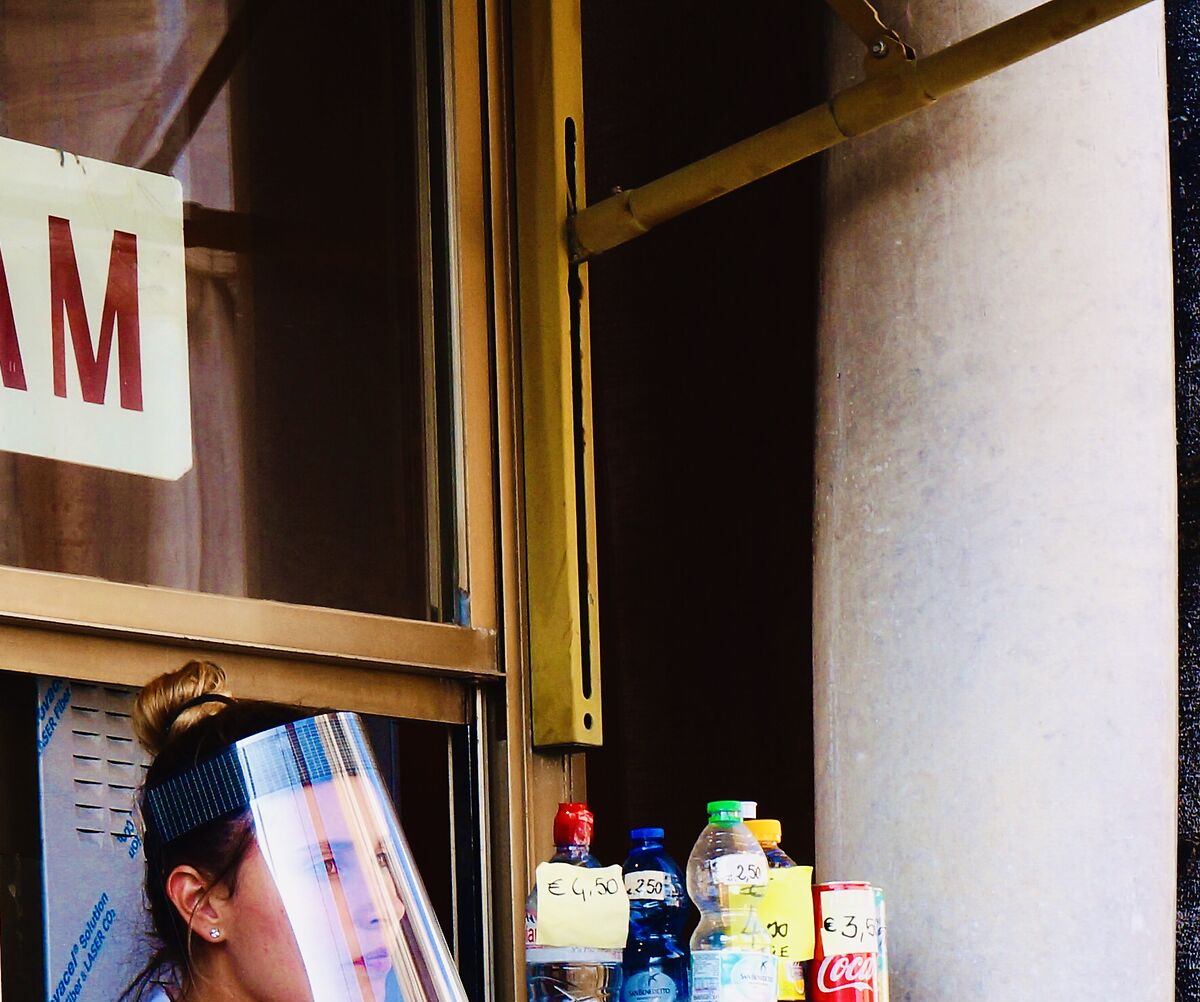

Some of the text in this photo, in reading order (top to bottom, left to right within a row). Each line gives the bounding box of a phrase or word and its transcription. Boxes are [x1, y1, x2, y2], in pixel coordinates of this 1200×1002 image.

[547, 877, 566, 897] €
[79, 892, 110, 950] Solution
[823, 916, 837, 933] €
[83, 928, 106, 973] LASER
